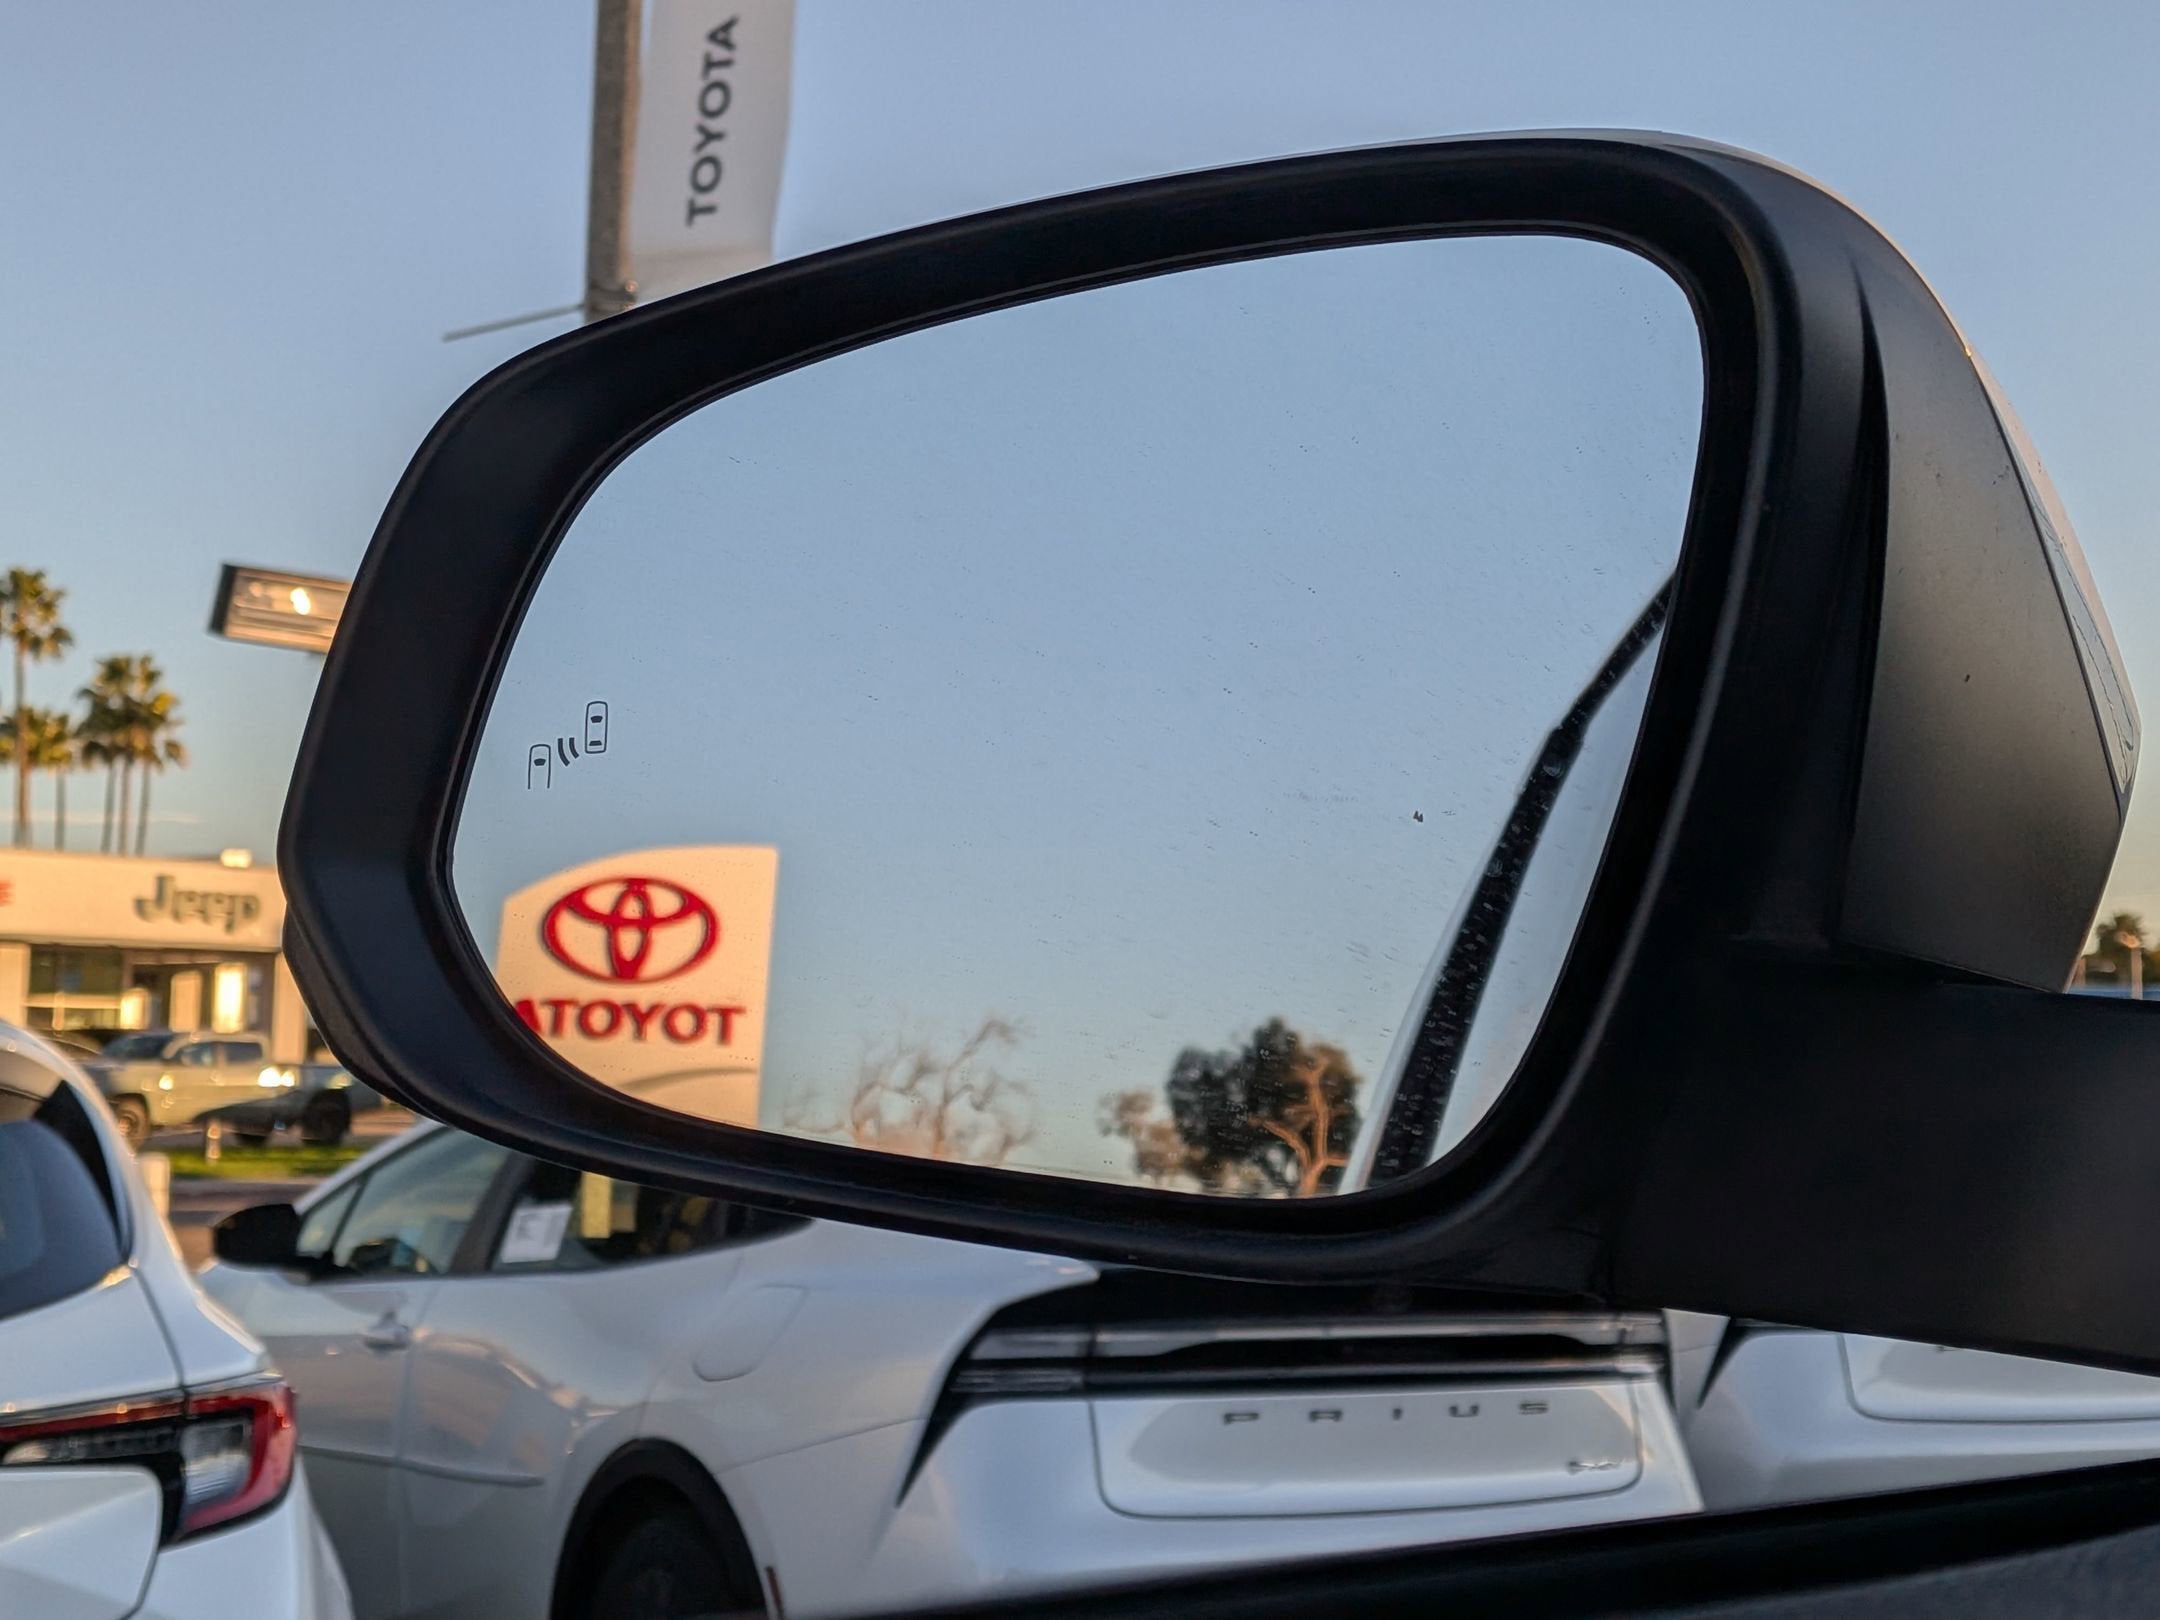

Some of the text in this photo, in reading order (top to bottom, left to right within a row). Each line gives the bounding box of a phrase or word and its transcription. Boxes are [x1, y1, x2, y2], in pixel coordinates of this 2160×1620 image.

[686, 15, 739, 227] TOYOTA
[134, 874, 260, 934] Jeep
[1222, 1400, 1550, 1425] PRIUS
